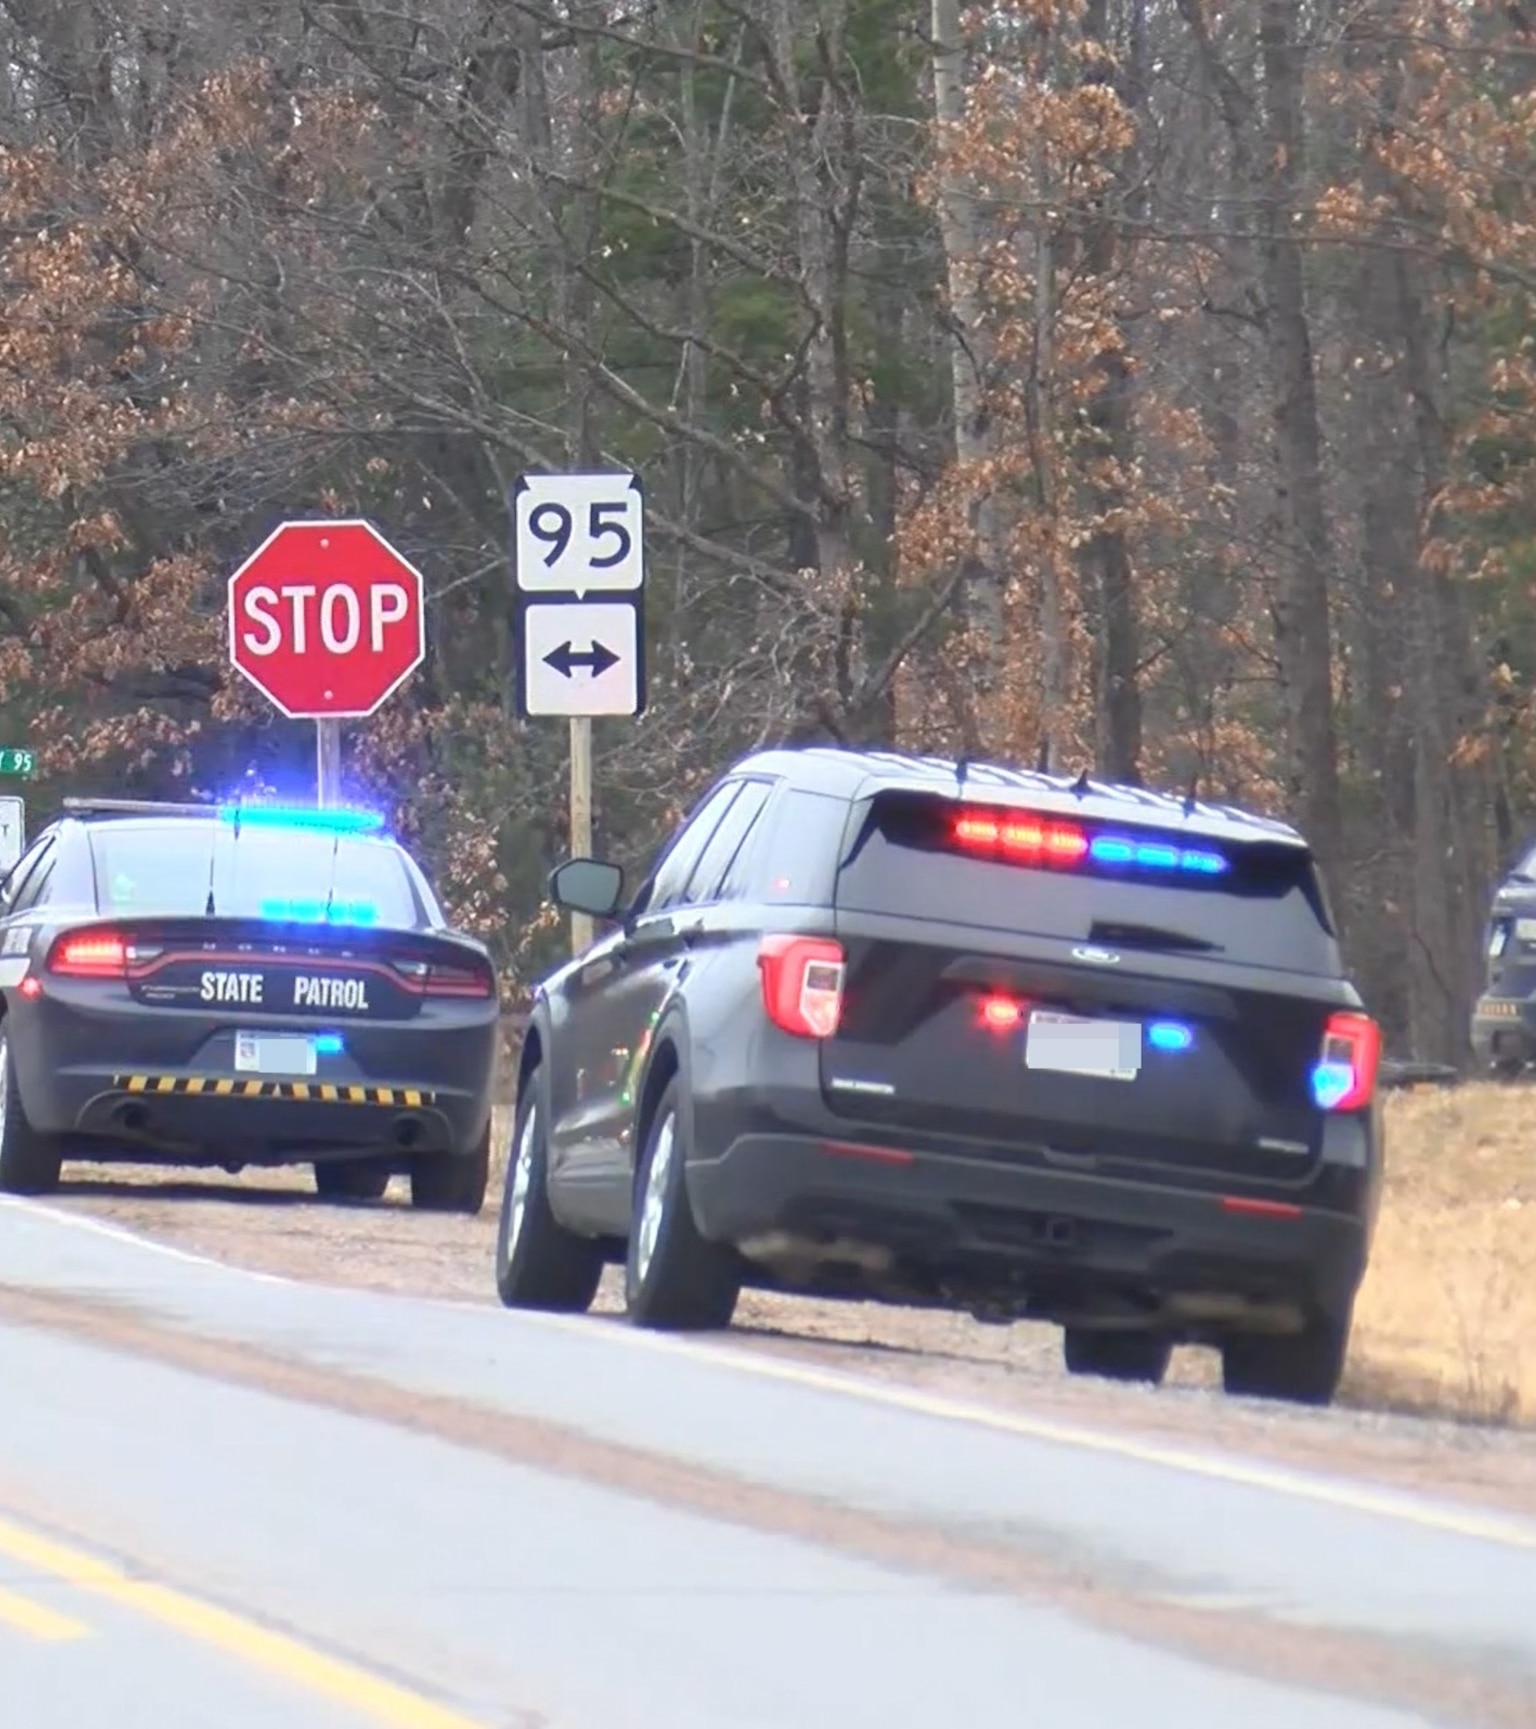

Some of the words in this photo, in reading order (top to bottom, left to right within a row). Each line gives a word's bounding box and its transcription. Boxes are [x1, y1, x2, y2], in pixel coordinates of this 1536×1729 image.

[528, 501, 632, 569] 95
[242, 582, 410, 657] STOP
[13, 752, 33, 773] 95
[200, 971, 264, 1003] STATE
[293, 976, 369, 1010] PATROL
